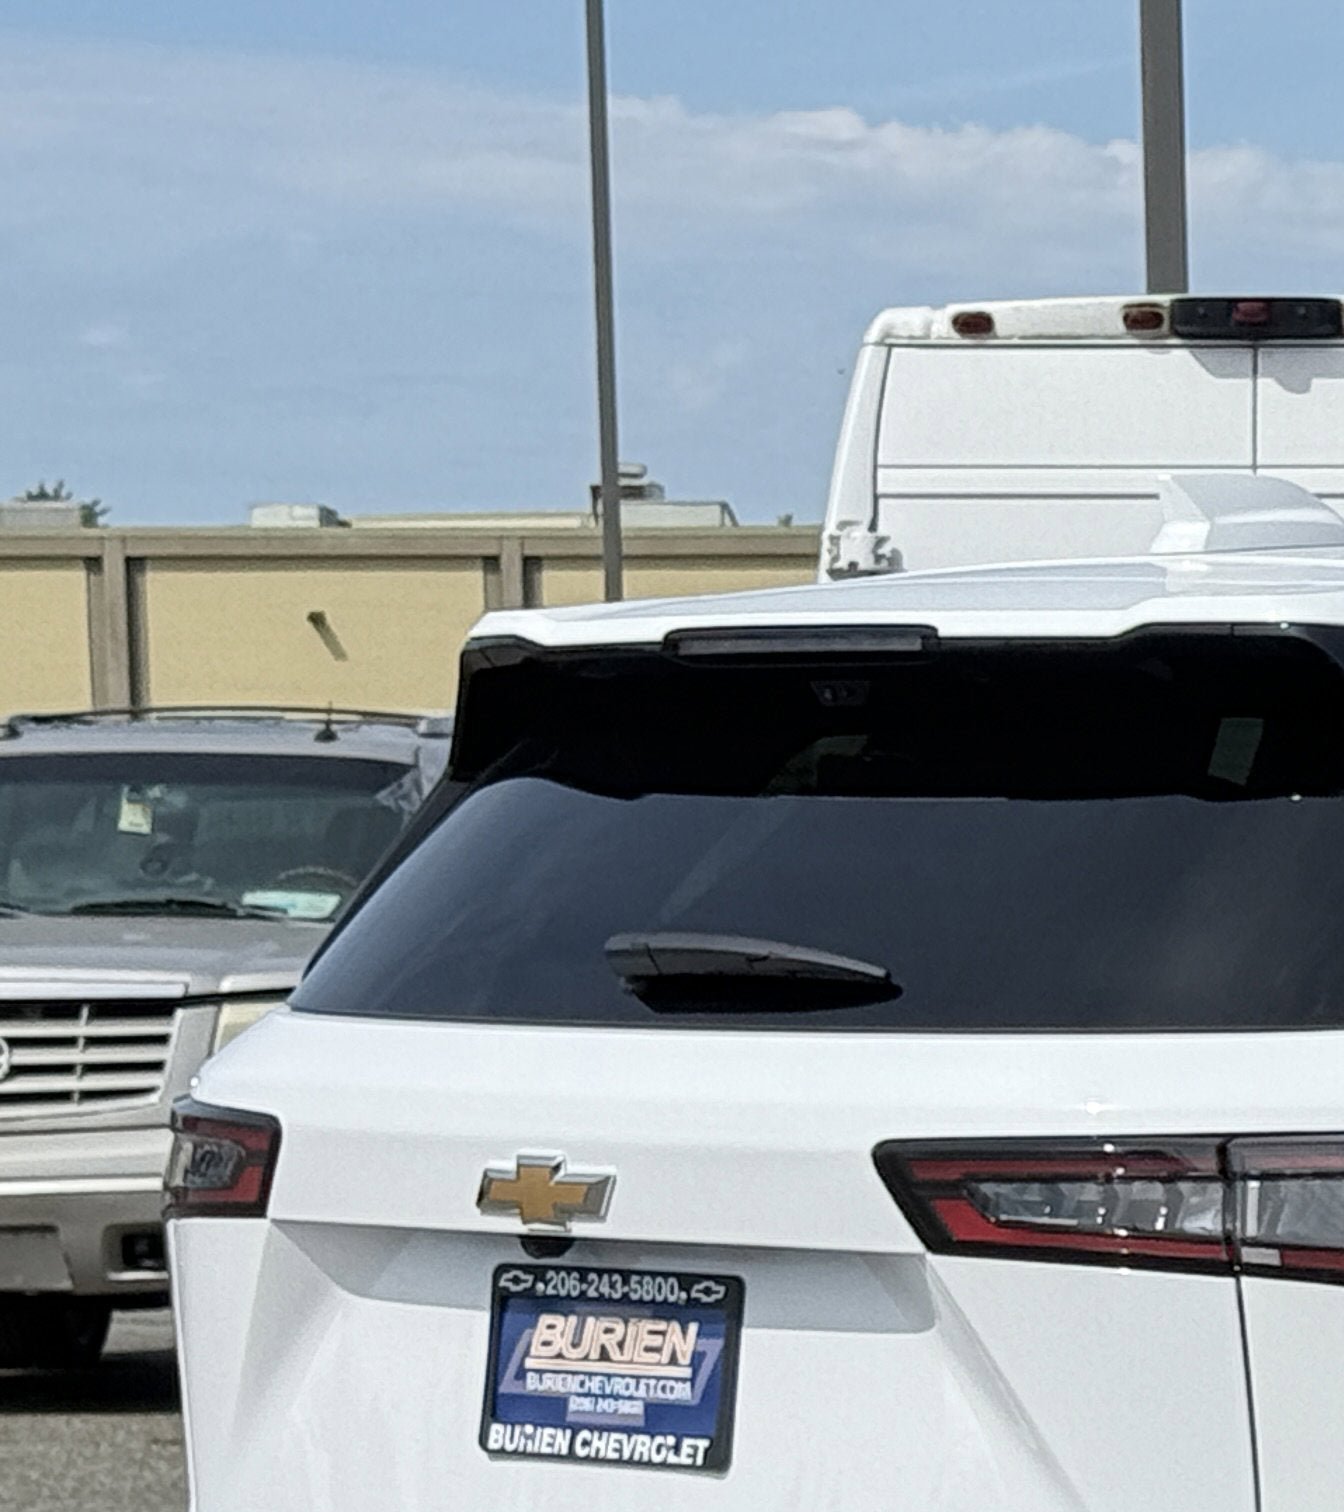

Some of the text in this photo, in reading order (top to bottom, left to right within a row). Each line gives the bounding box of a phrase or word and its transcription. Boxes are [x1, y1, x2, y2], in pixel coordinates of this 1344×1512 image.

[545, 1269, 680, 1301] 206-243-5800
[530, 1313, 700, 1365] BURIEN
[525, 1371, 693, 1401] BURIENCHEVROLET.COM
[487, 1422, 711, 1467] BURIEN CHEVROLET
